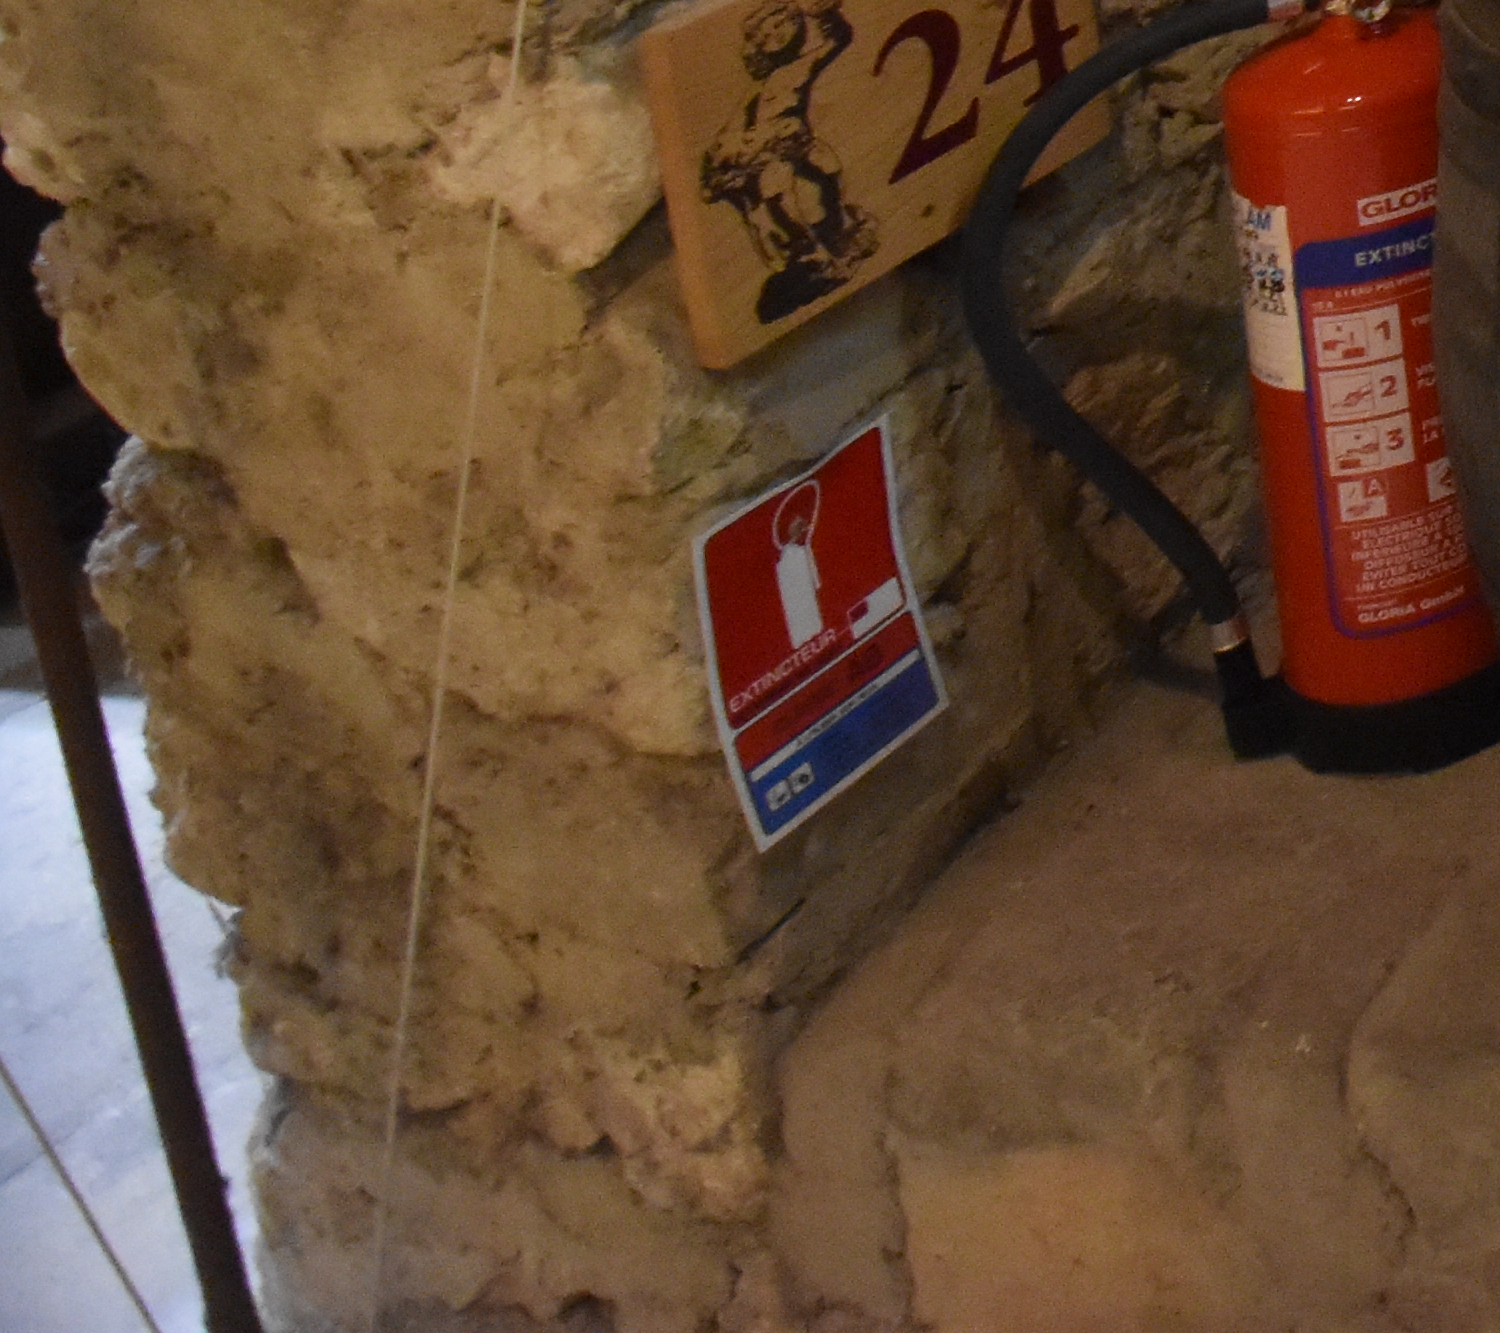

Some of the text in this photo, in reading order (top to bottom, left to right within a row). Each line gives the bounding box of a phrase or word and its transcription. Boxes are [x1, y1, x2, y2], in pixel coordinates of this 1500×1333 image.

[1355, 234, 1432, 267] EXTINC
[1374, 319, 1391, 341] 1
[1379, 375, 1398, 398] 2
[1386, 428, 1404, 451] 3
[729, 628, 838, 714] EXTINCTEUR
